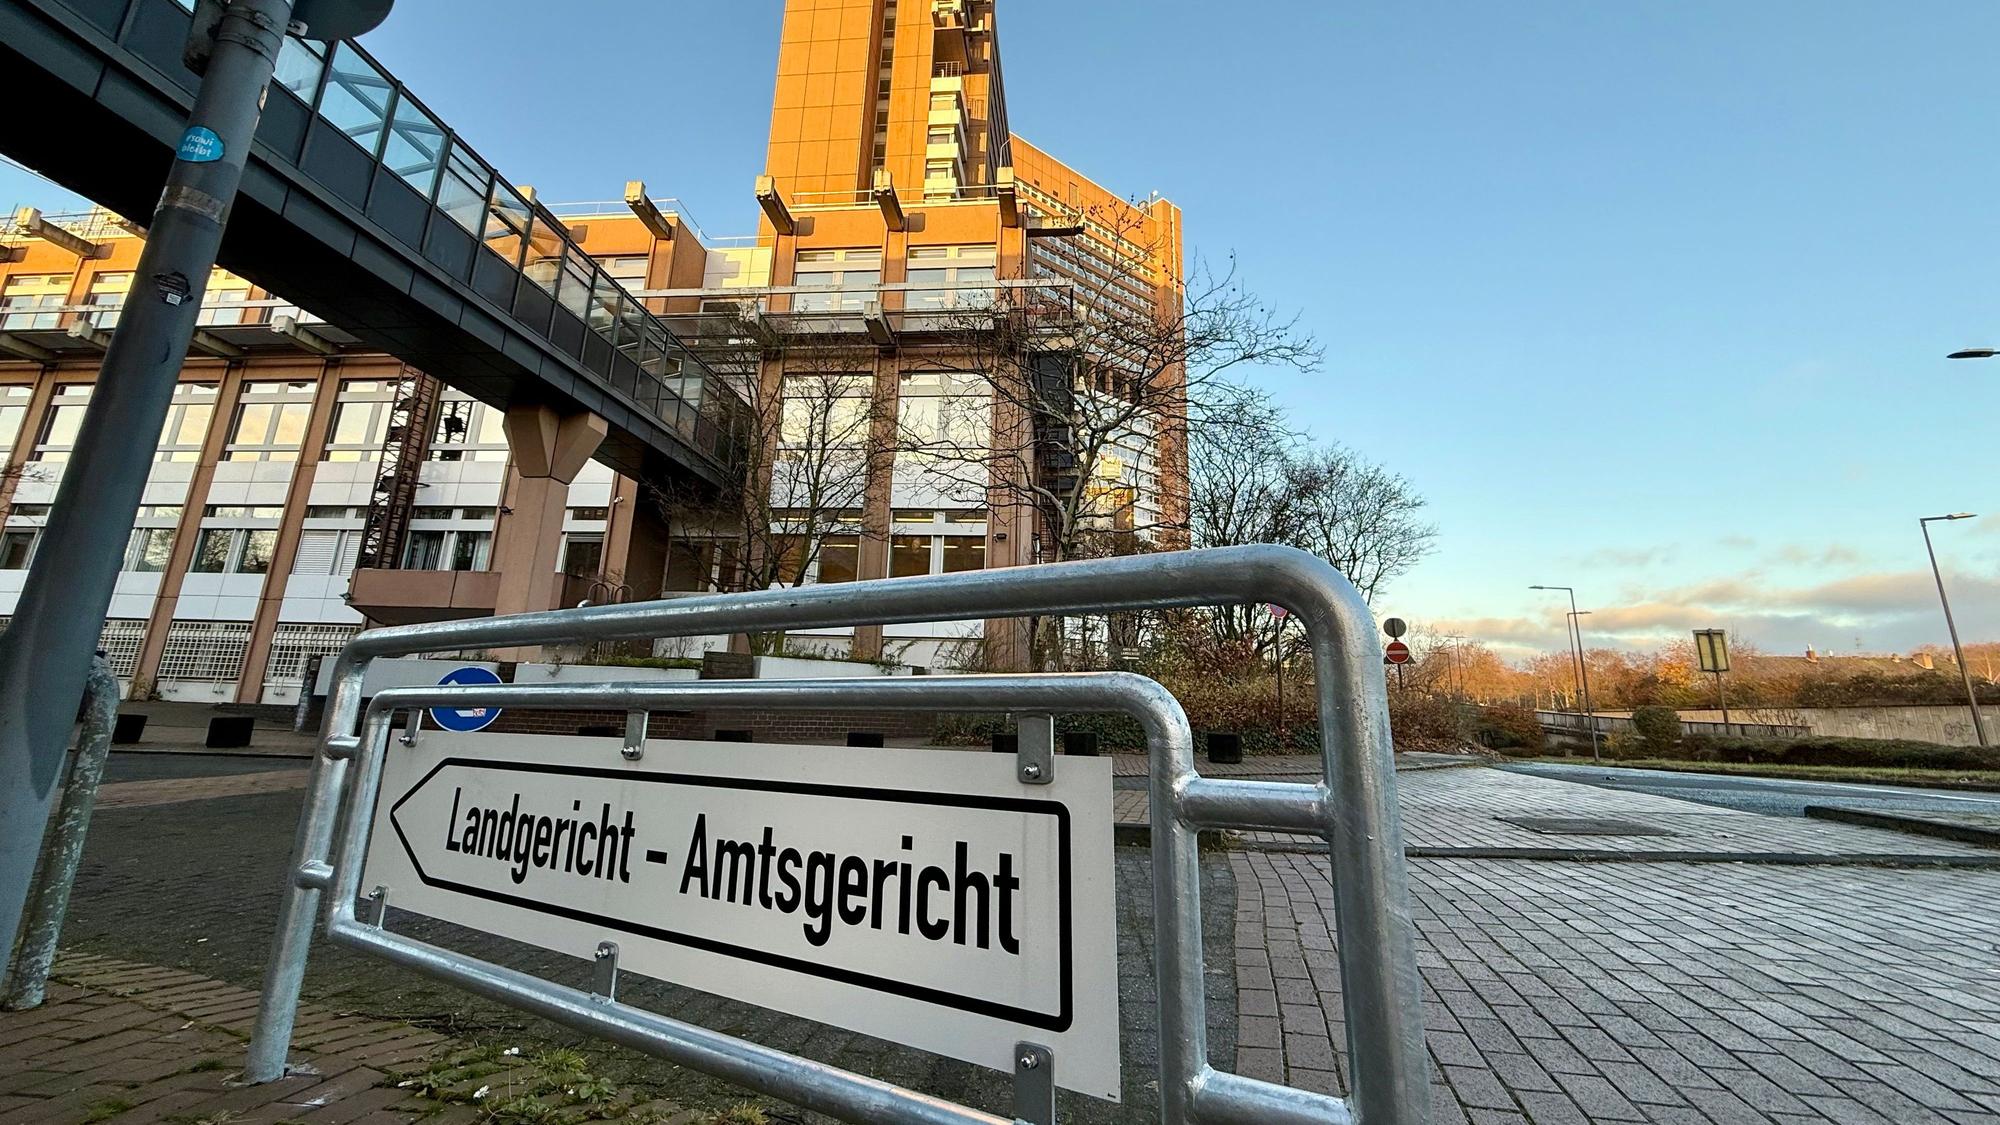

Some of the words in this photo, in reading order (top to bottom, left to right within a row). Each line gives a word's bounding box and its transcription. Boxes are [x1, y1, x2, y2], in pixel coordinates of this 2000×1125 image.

[445, 786, 635, 884] Landgericht
[646, 849, 668, 864] -
[679, 813, 1020, 956] Amtsgericht
